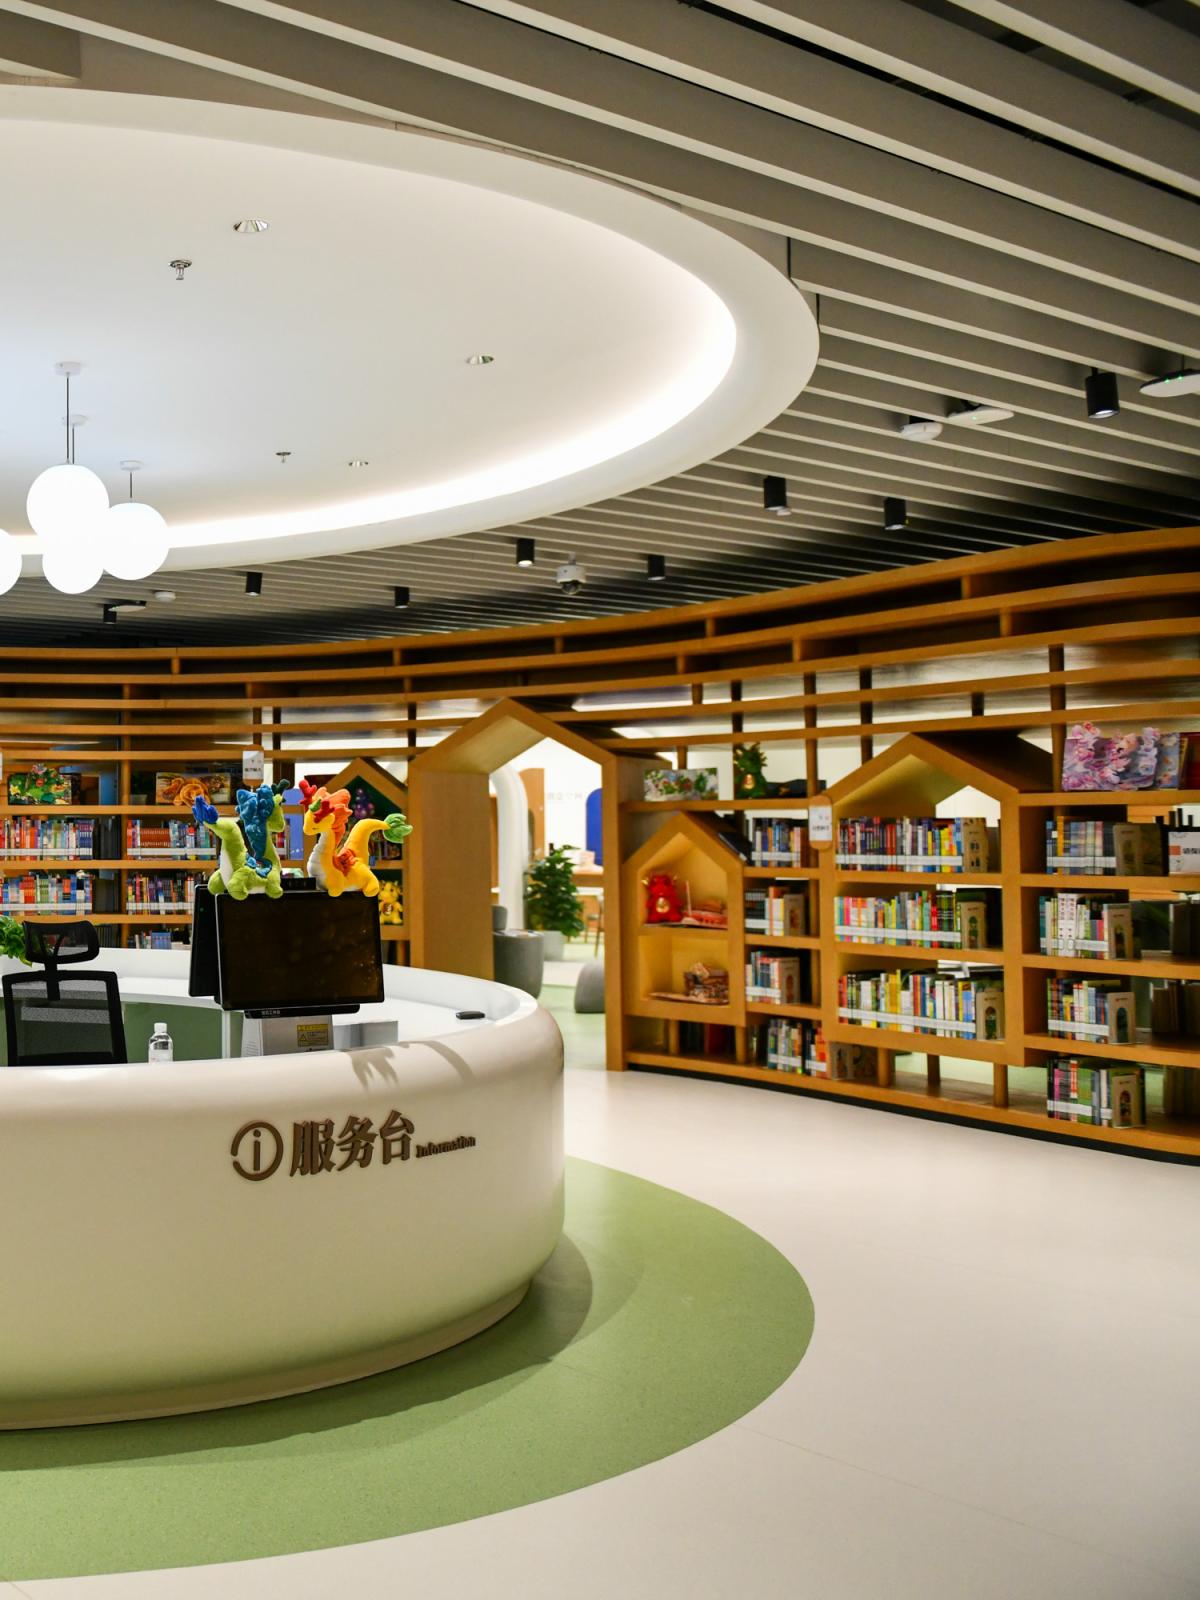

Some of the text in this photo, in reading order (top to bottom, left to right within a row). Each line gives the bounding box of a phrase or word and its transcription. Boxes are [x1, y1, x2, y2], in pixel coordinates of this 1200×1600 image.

[290, 1110, 476, 1177] 服务台 Information
